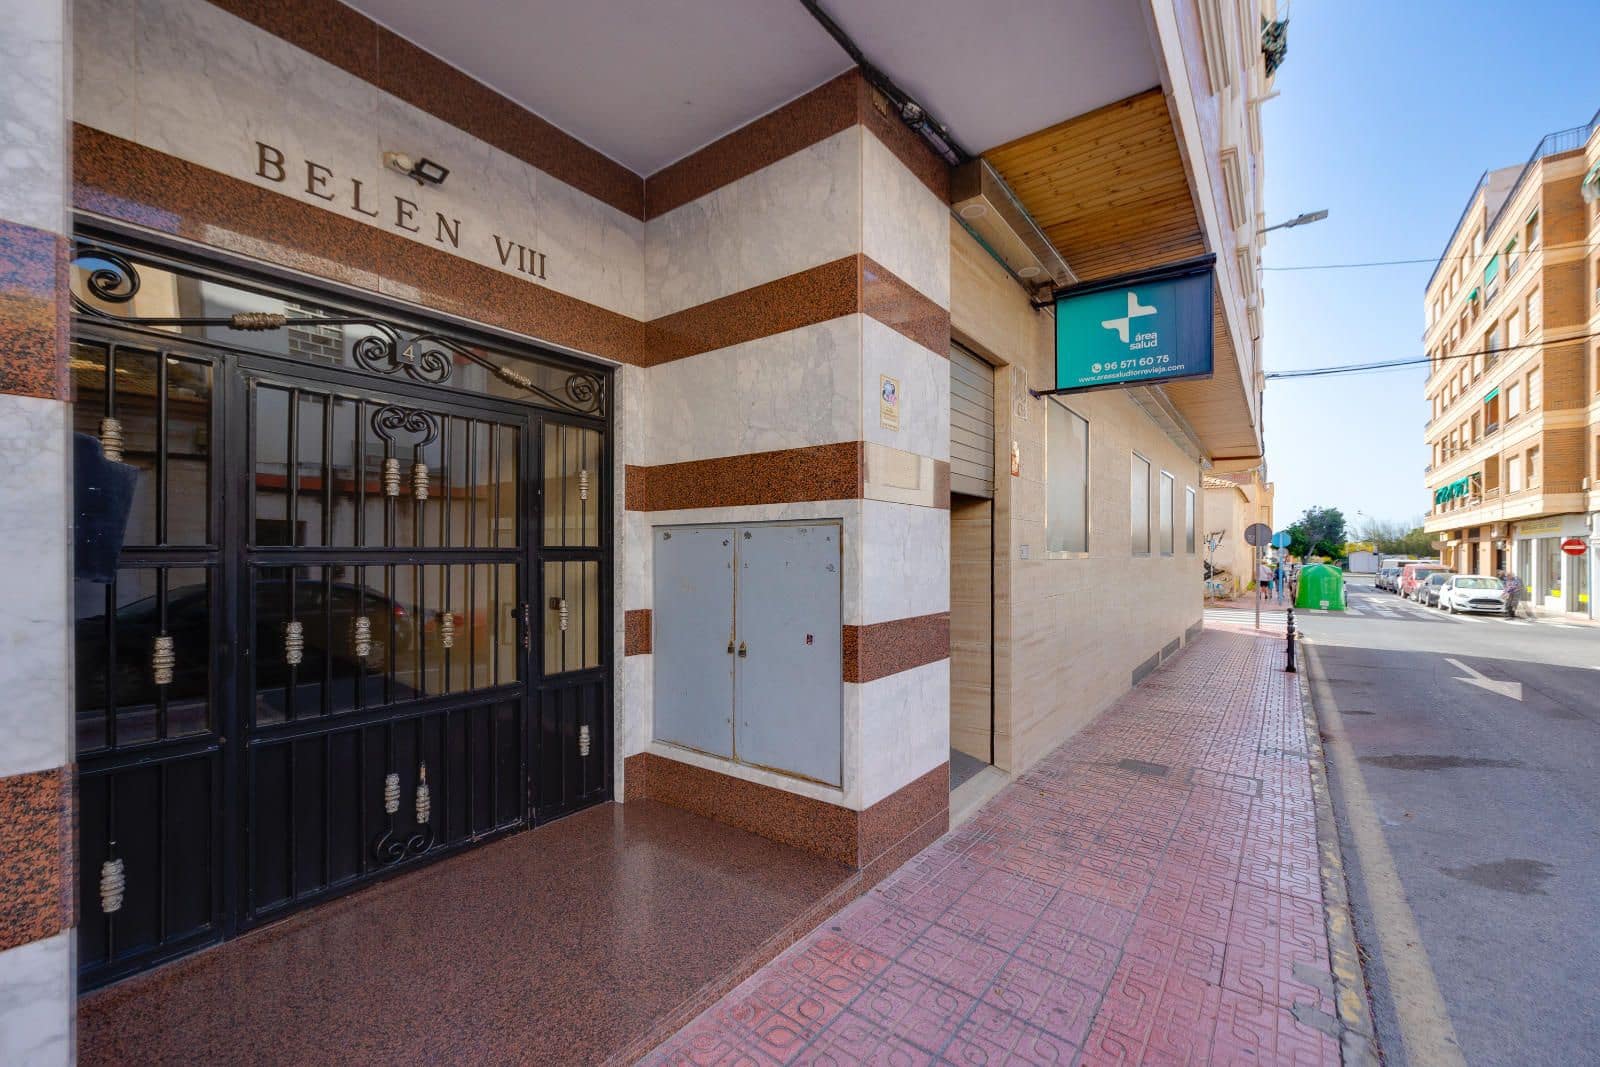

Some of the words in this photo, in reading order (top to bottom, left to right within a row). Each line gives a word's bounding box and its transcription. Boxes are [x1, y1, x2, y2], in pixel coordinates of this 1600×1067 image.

[255, 141, 461, 248] BELEN
[492, 234, 547, 280] VIII
[1129, 340, 1158, 350] salud
[1135, 332, 1158, 341] área
[402, 344, 415, 361] 4
[1103, 361, 1118, 371] 96
[1120, 359, 1136, 369] 571
[1139, 356, 1154, 366] 60
[1156, 354, 1170, 364] 75
[1078, 363, 1185, 383] www.areasaludtorrevieja.com
